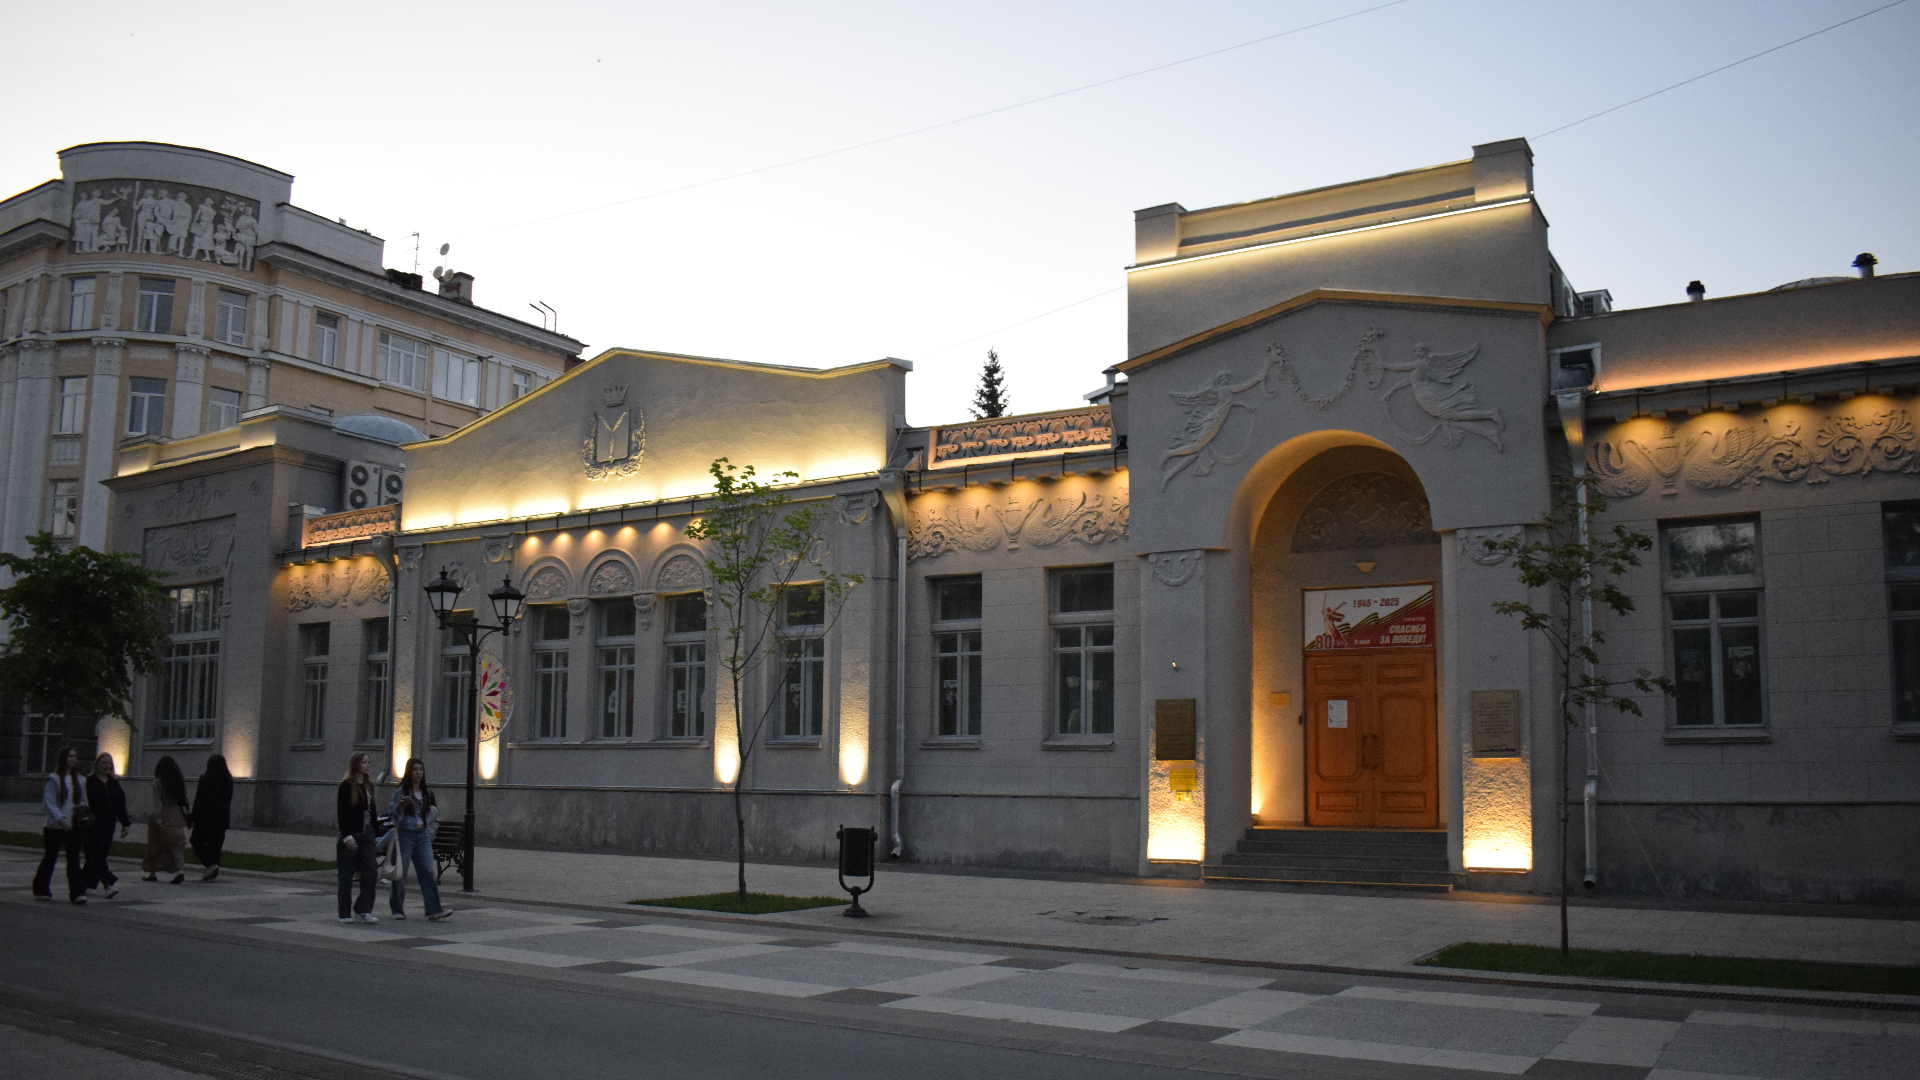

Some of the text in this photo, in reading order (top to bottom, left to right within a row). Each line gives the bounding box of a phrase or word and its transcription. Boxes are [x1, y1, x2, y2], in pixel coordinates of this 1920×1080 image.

[1353, 599, 1371, 608] 1945
[1380, 598, 1400, 606] 2025
[1390, 624, 1426, 634] СПАСИБО
[1315, 634, 1333, 649] 80
[1380, 634, 1426, 644] ЗА ПОБЕДУ!
